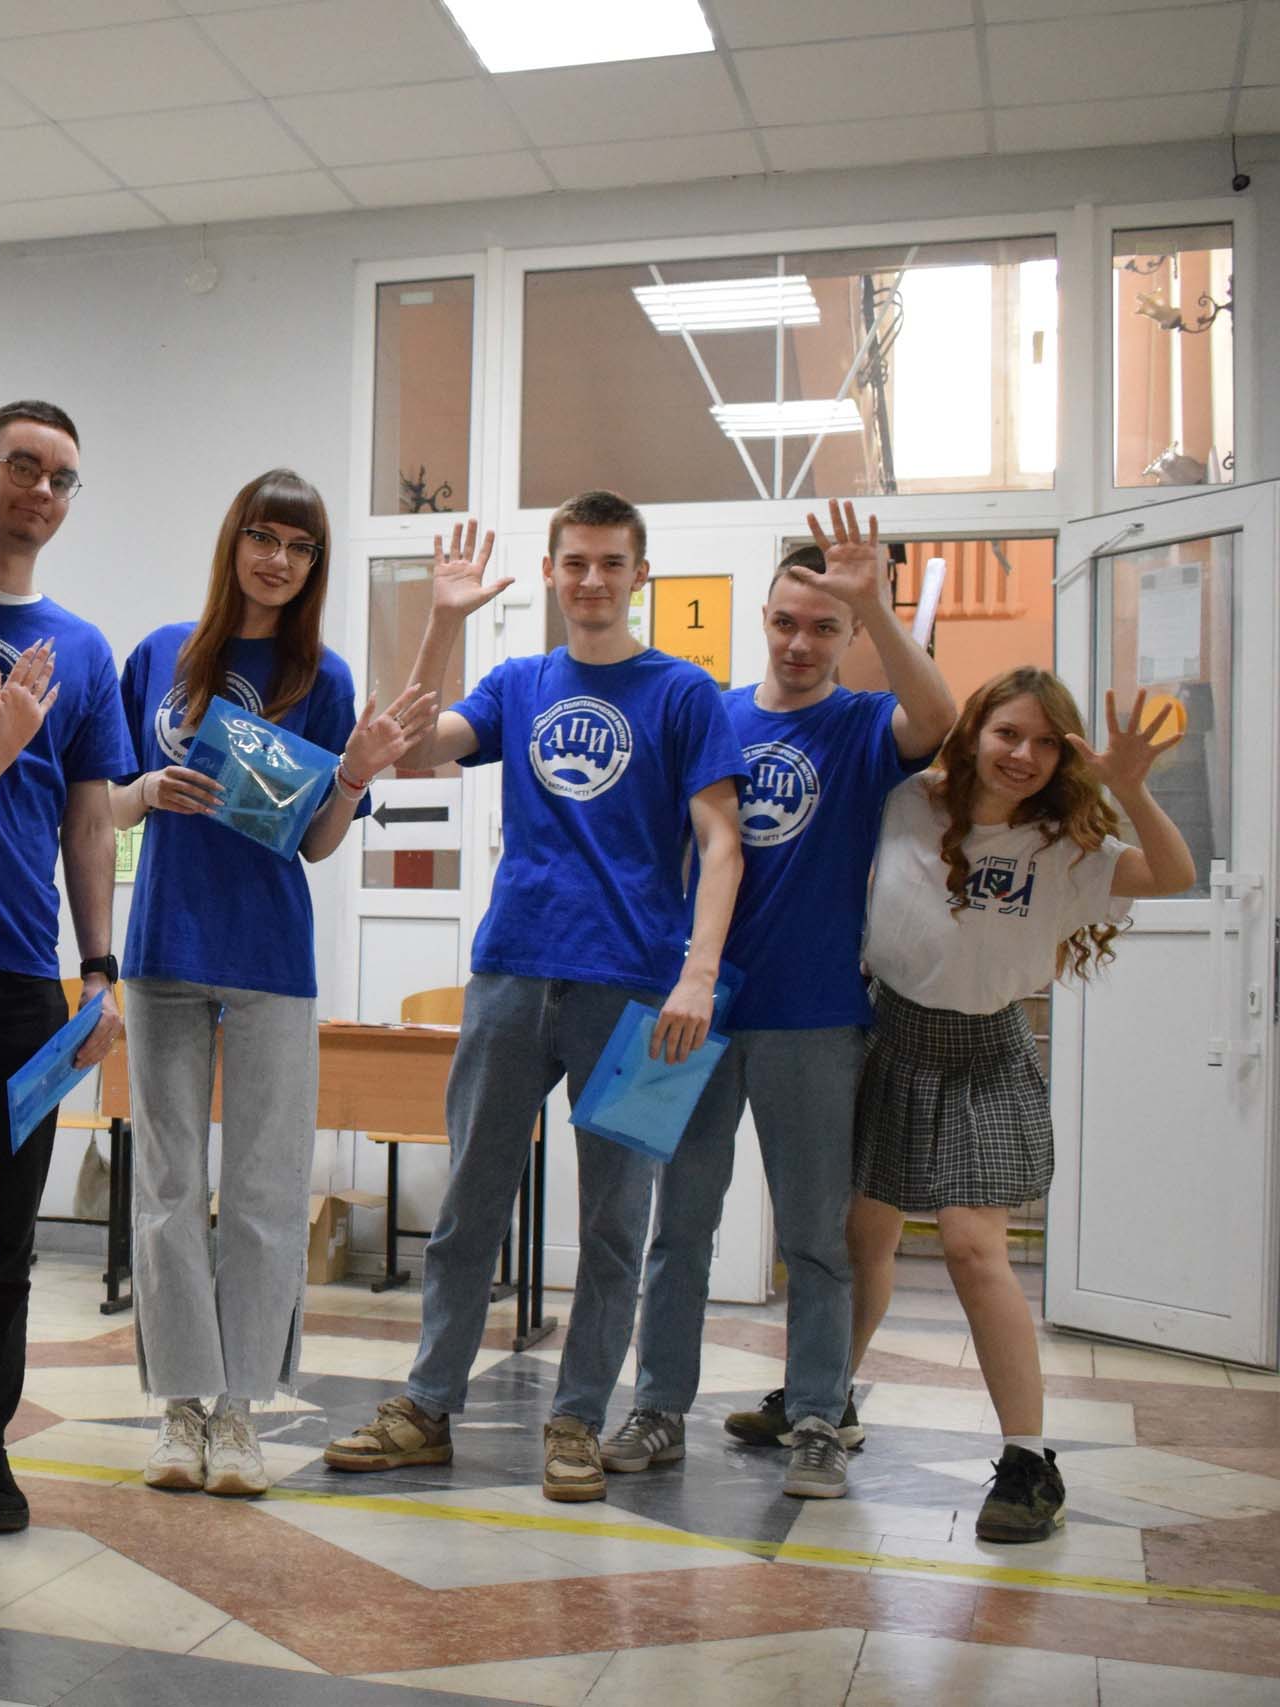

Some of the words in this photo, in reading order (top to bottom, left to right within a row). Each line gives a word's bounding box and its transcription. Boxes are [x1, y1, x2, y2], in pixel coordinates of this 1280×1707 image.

[687, 599, 705, 629] 1
[677, 654, 714, 667] ТАЖ
[544, 717, 609, 753] АПИ
